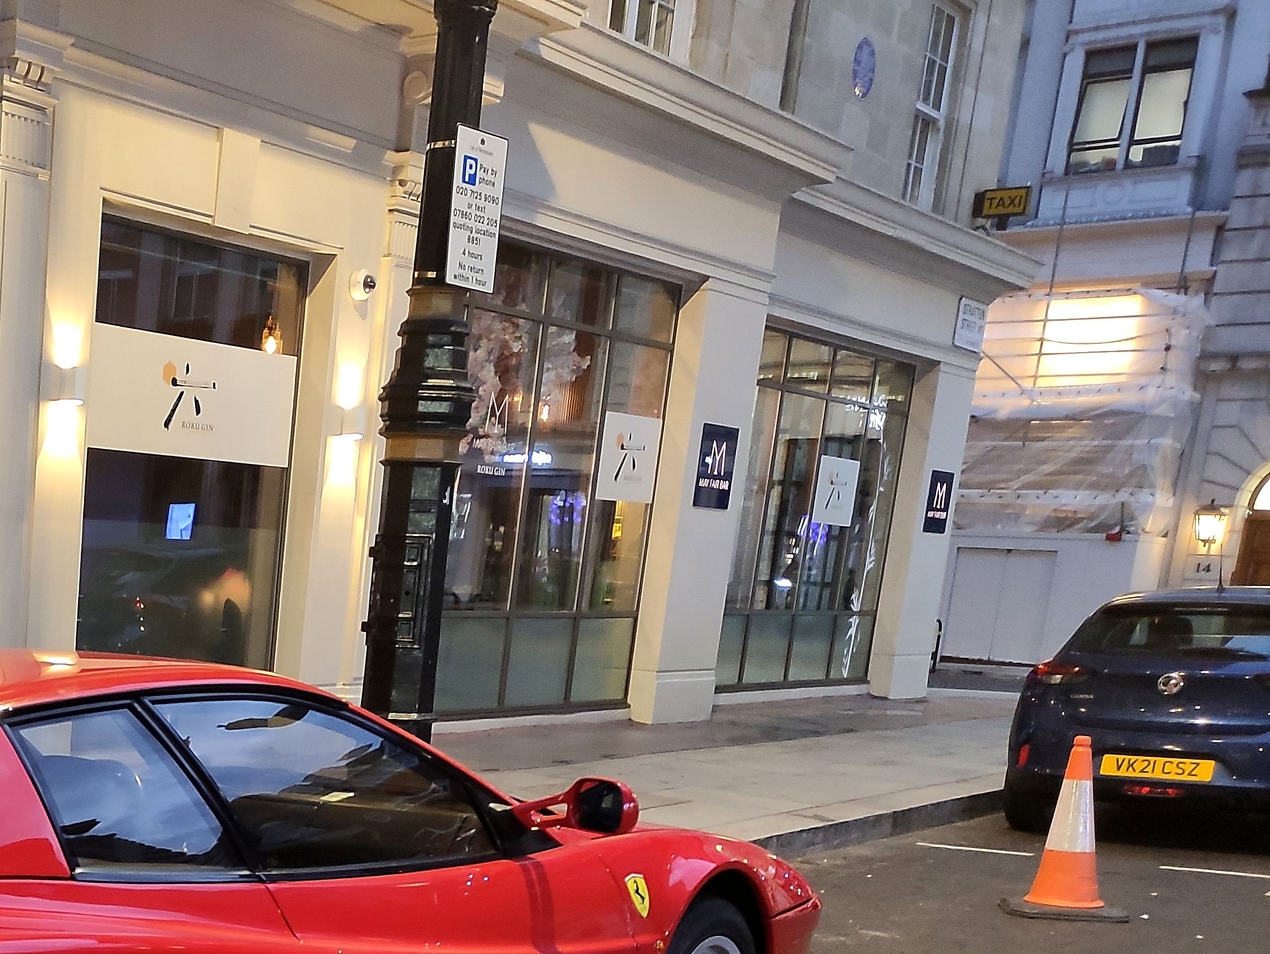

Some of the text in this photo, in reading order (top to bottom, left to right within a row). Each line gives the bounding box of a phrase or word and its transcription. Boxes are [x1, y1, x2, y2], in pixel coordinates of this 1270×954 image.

[465, 158, 476, 182] P
[479, 163, 498, 178] Pay by
[479, 176, 495, 188] phone
[456, 185, 499, 205] 020 7125 9090
[986, 195, 1023, 209] TAXI
[475, 203, 486, 213] text
[453, 208, 498, 228] 07860 022 205
[452, 221, 496, 238] quoting location
[466, 234, 481, 246] 8851
[461, 248, 483, 261] 4 hours
[458, 261, 485, 275] No return
[453, 273, 469, 282] within
[475, 277, 487, 287] hour
[181, 420, 214, 431] ROKU GIN
[494, 467, 506, 476] GIN
[698, 477, 709, 487] MAY
[720, 480, 729, 490] BAR
[1196, 562, 1212, 573] 14
[1115, 757, 1200, 777] VK21 CSZ
